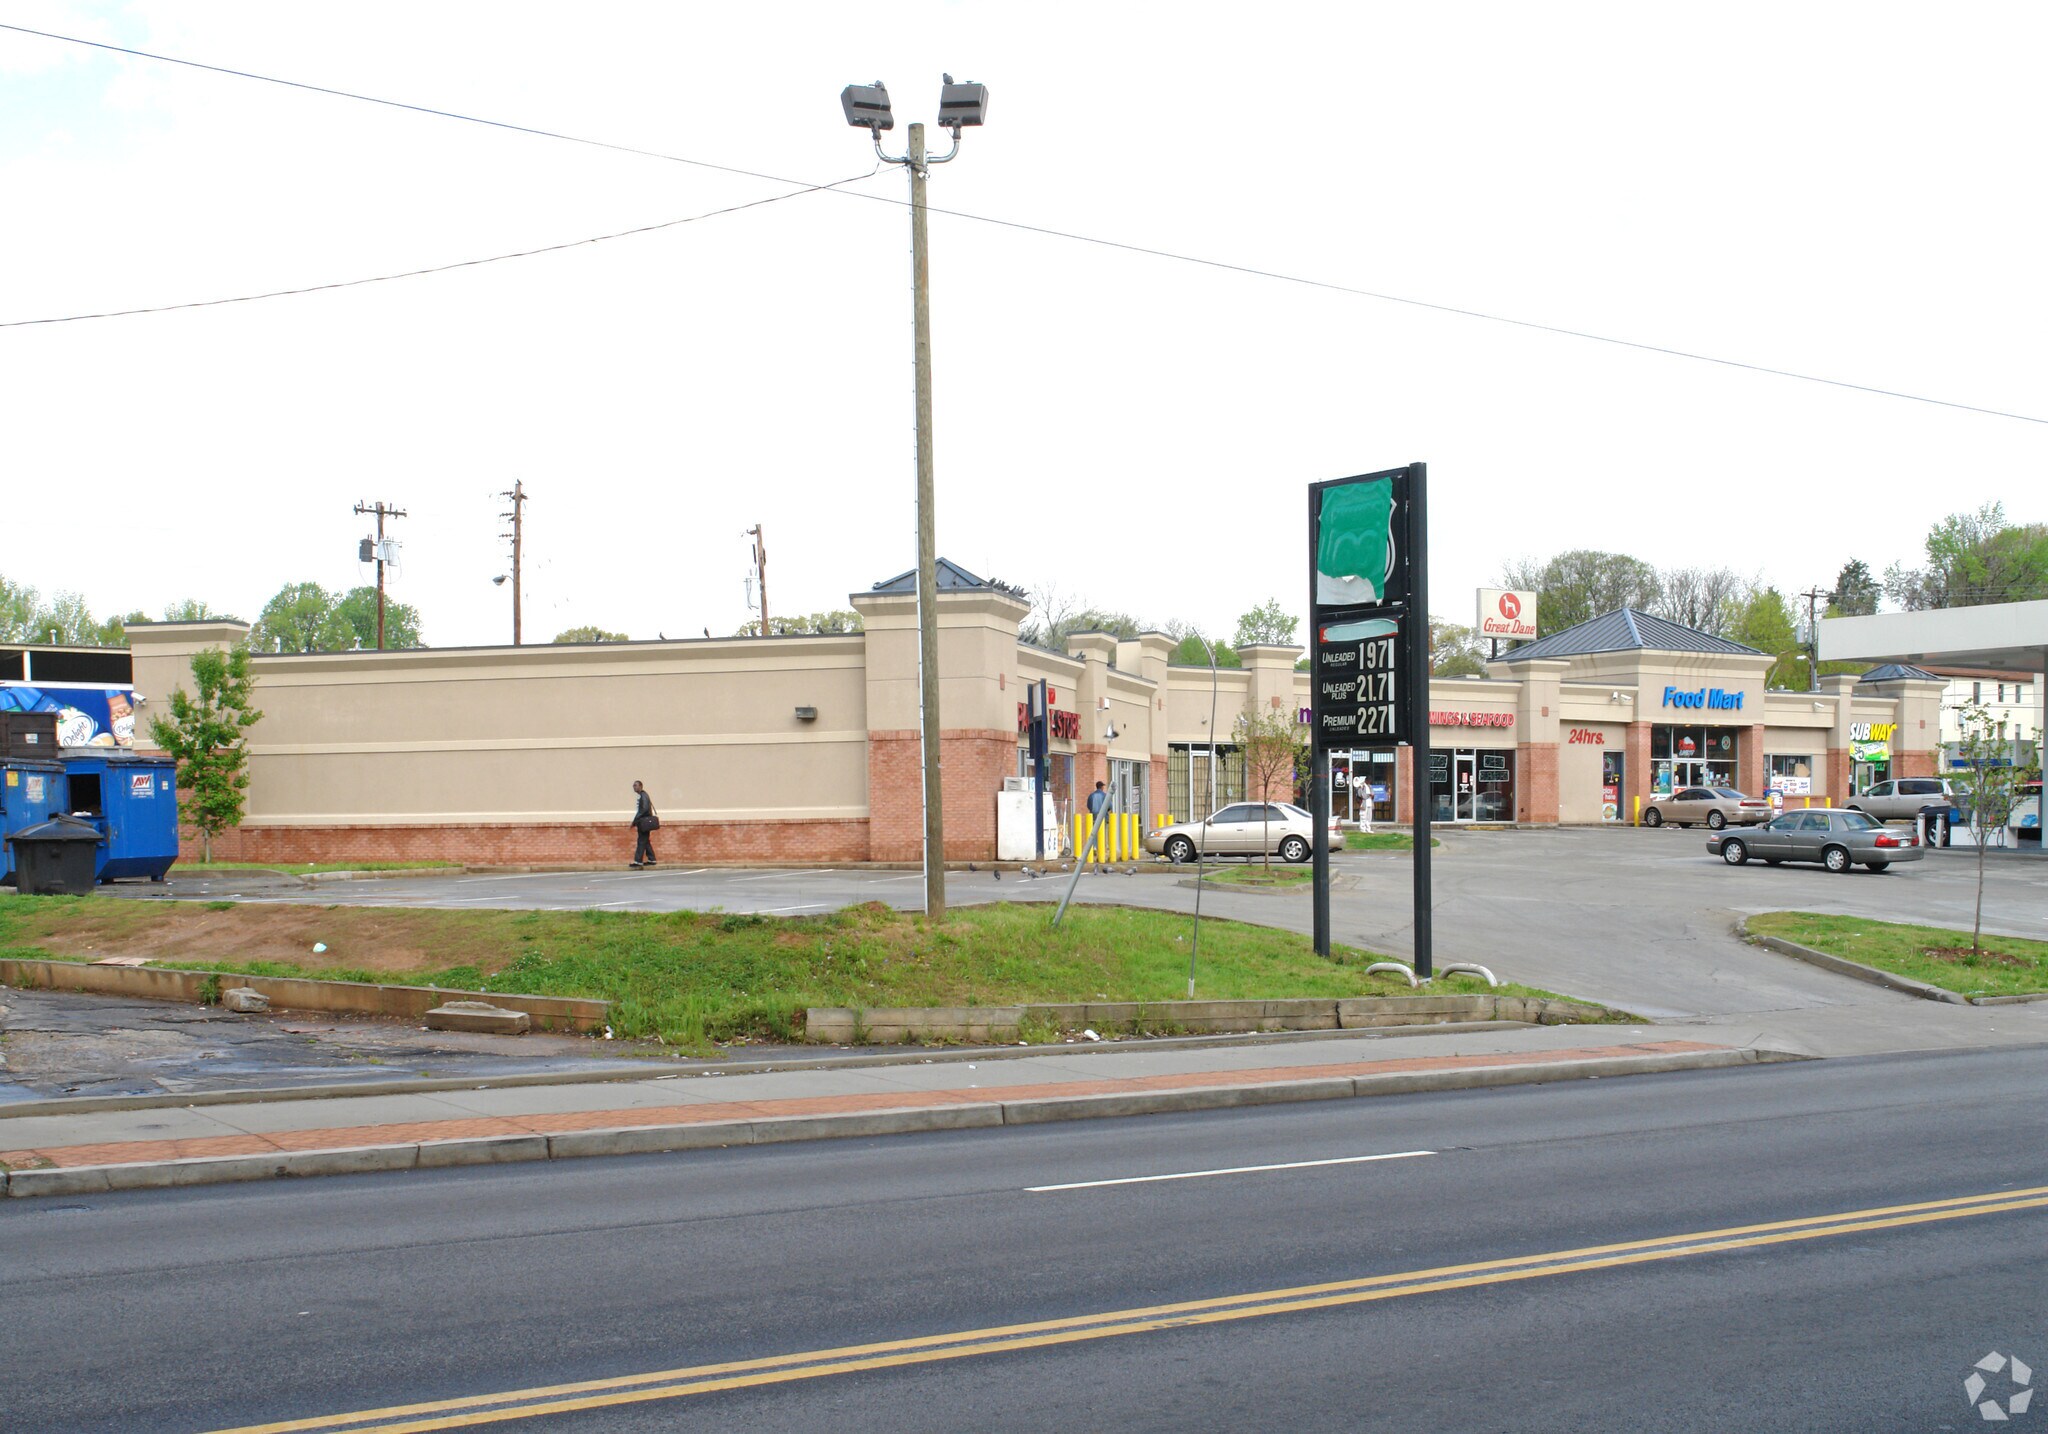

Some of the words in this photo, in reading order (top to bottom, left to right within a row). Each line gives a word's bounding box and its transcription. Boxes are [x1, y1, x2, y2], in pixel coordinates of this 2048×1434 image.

[1483, 617, 1510, 633] Great
[1511, 619, 1536, 634] Dane
[1322, 651, 1356, 663] UNLEADED
[1359, 640, 1387, 669] 197
[1322, 682, 1356, 694] UNLEADED
[1331, 692, 1347, 700] PLUS
[1662, 686, 1706, 708] Food
[1707, 688, 1744, 710] Mart
[1057, 710, 1082, 740] STORE
[1322, 715, 1356, 727] PREMIUM
[1357, 706, 1388, 735] 227
[1428, 711, 1459, 726] WINGS
[1461, 713, 1468, 725] &
[1470, 713, 1514, 726] SEAFOOD
[1569, 728, 1605, 744] 24hrs.
[1850, 722, 1897, 741] SUBWAY
